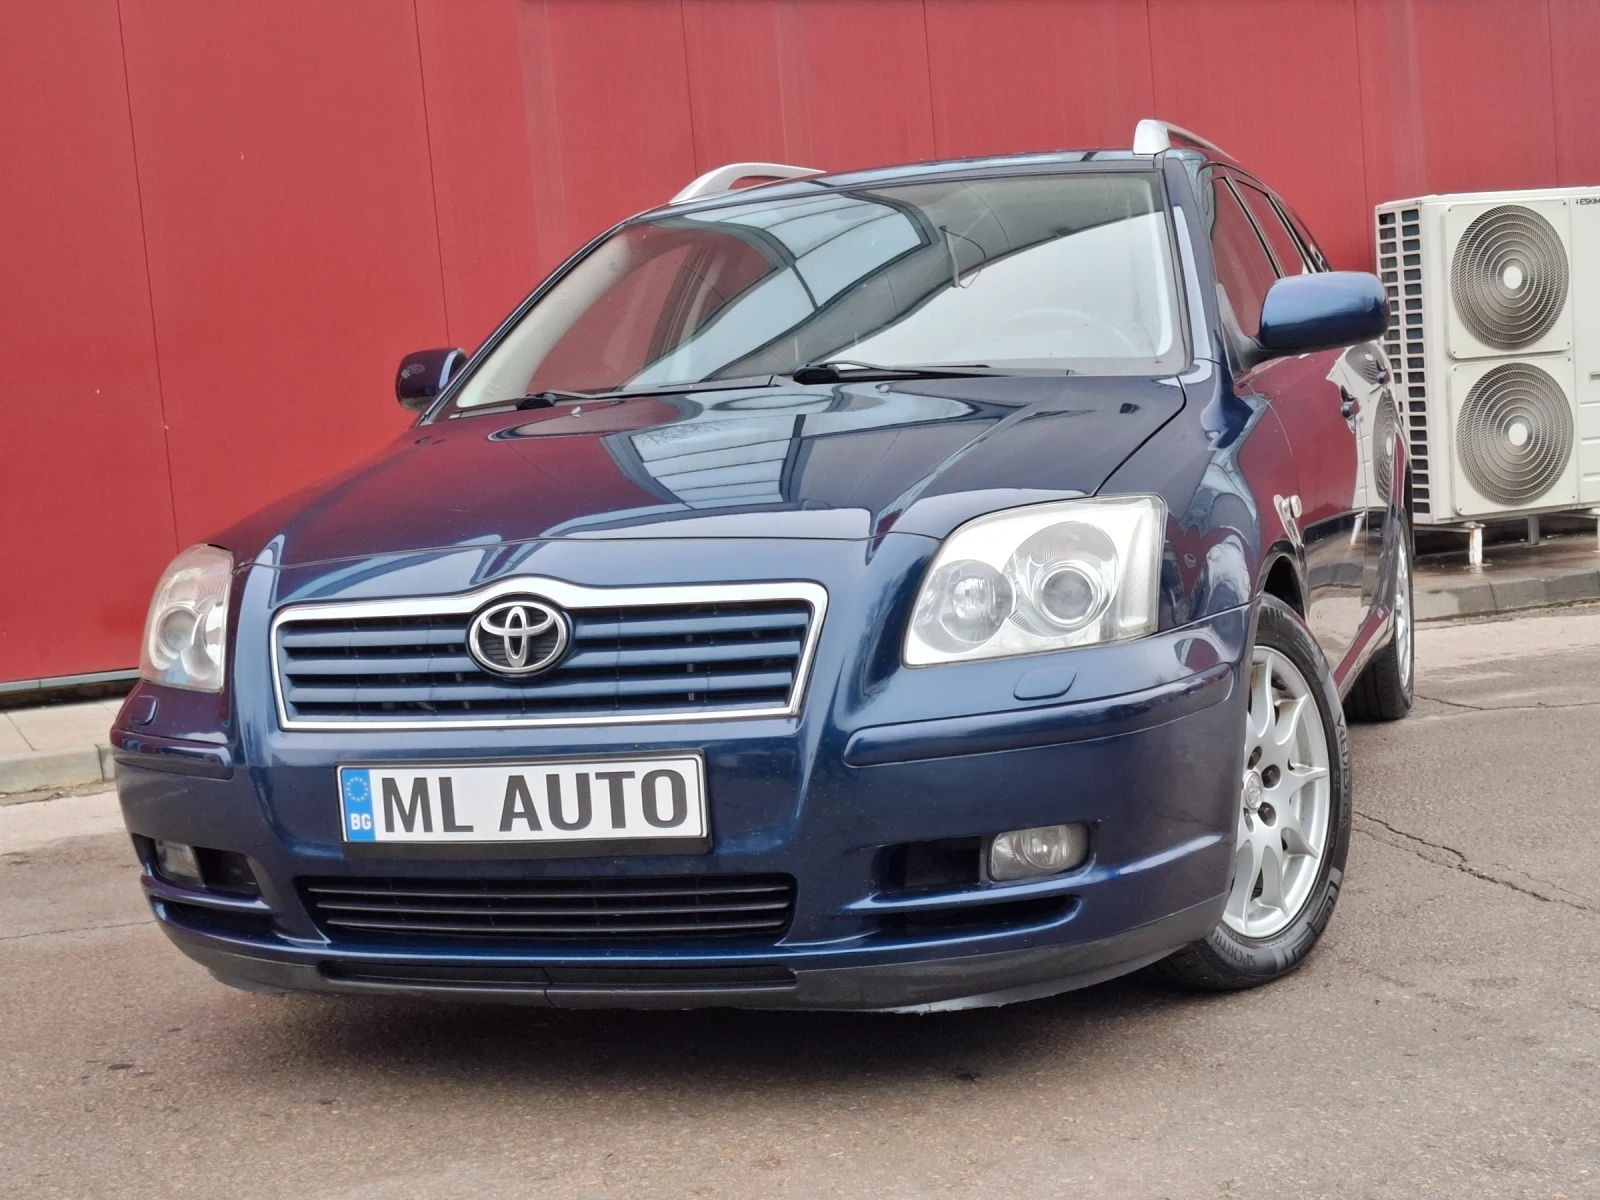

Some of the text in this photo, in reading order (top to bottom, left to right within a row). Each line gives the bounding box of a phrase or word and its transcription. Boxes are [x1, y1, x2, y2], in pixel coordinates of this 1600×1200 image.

[381, 769, 688, 833] ML AUTO
[350, 813, 371, 831] BG
[1212, 930, 1256, 967] SPORTR
